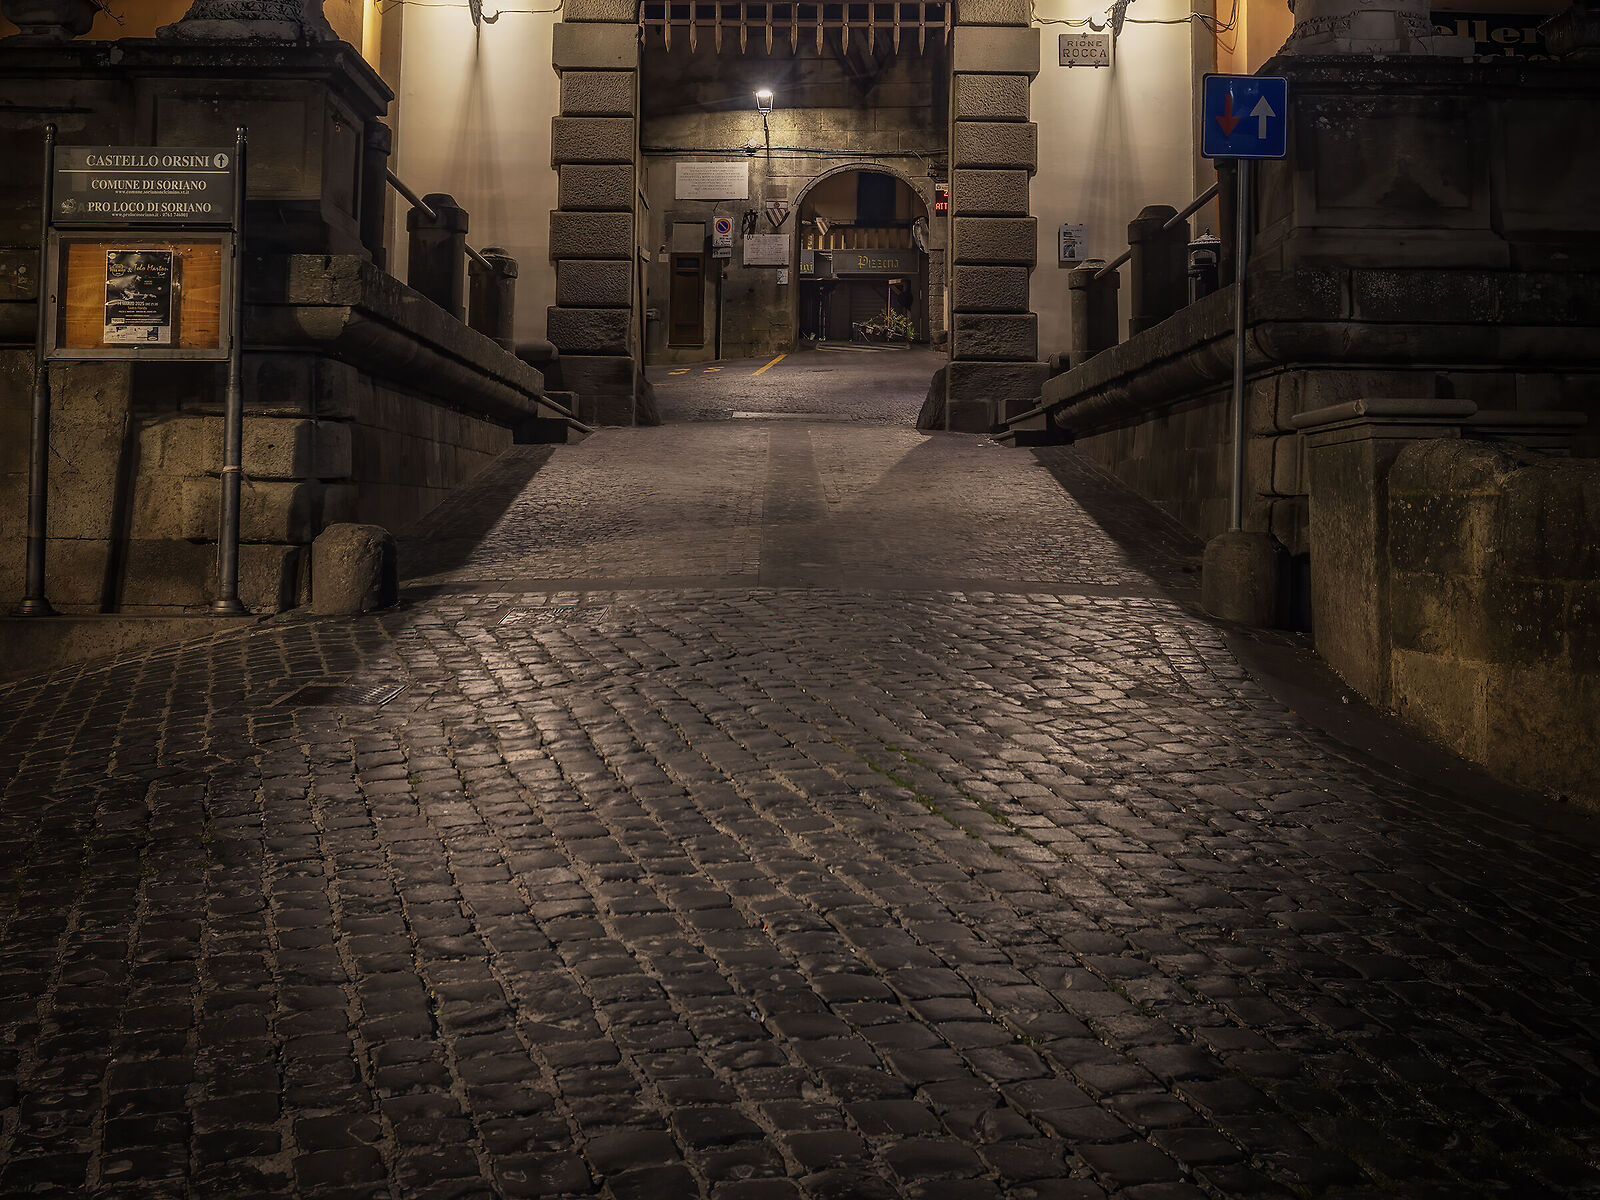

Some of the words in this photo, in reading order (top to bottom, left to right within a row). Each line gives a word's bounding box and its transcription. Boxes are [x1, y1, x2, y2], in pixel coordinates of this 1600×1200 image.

[1063, 48, 1107, 58] ROCCA
[86, 154, 159, 167] CASTELLO
[161, 155, 210, 167] ORSINI
[91, 179, 140, 190] COMUNE
[142, 180, 154, 190] DI
[156, 180, 207, 191] SORIANO
[88, 201, 111, 212] PRO
[113, 201, 145, 212] LOCO
[147, 202, 159, 212] DI
[161, 202, 212, 213] SORIANO
